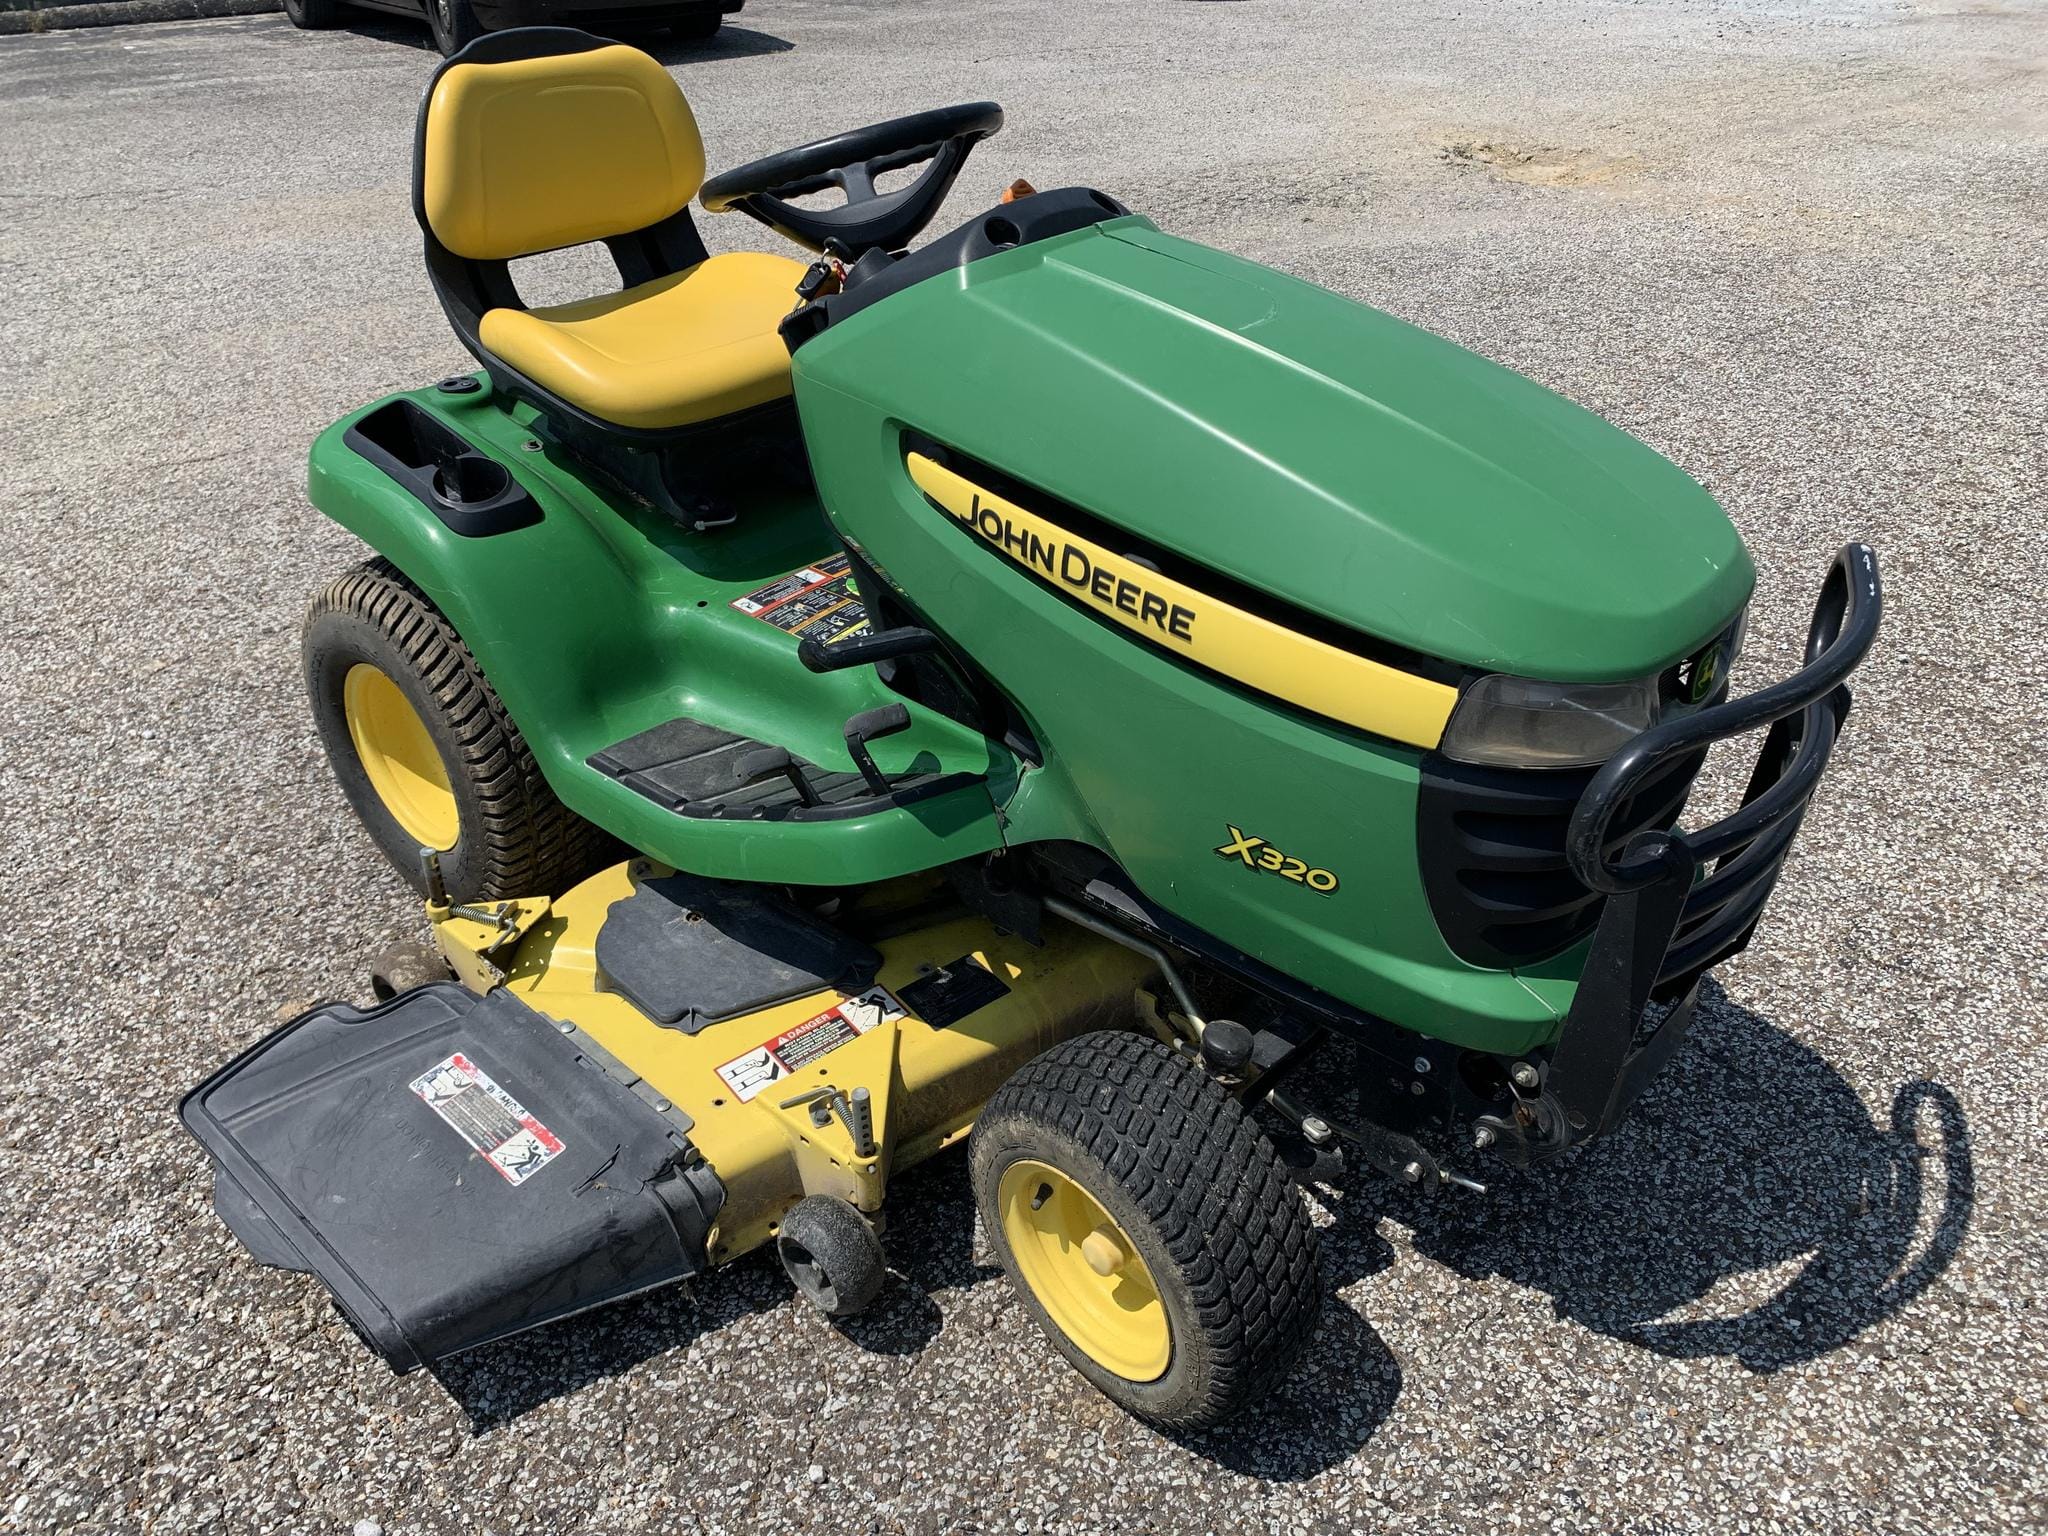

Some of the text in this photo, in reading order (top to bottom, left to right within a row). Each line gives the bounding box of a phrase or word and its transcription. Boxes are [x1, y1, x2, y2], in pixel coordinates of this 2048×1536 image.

[959, 494, 1056, 575] JOHN
[1061, 543, 1196, 643] DEERE
[1213, 823, 1339, 897] X320
[787, 1013, 830, 1040] DANGER
